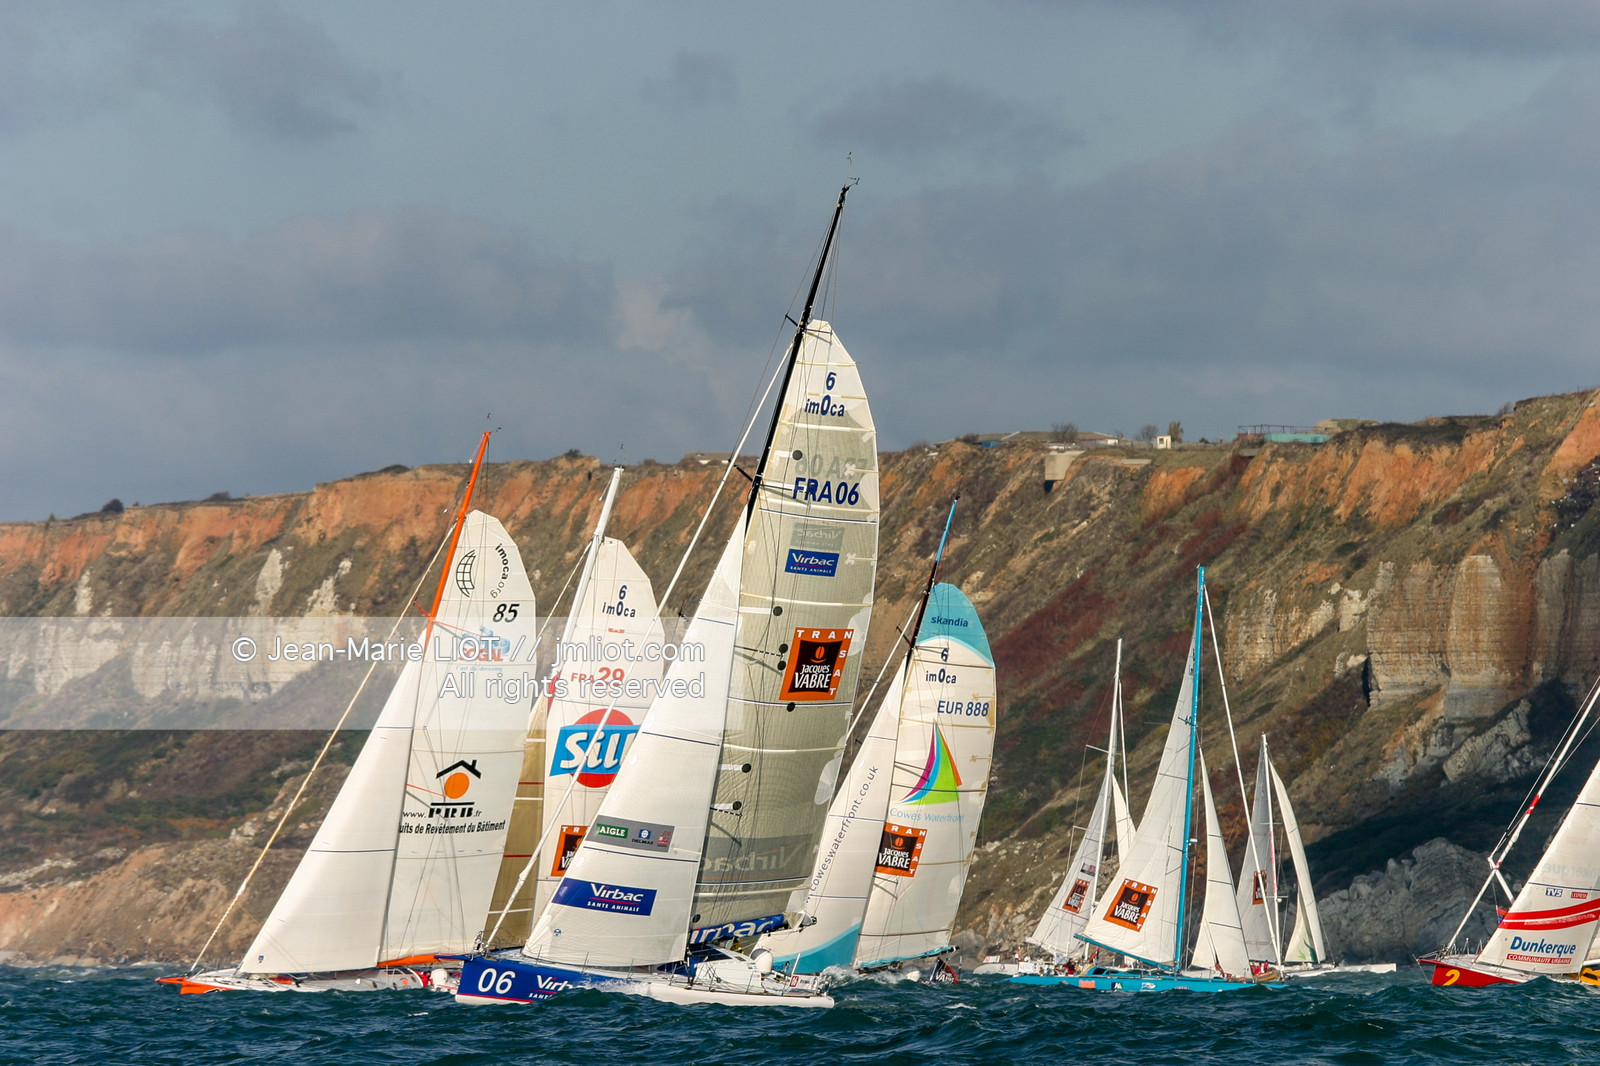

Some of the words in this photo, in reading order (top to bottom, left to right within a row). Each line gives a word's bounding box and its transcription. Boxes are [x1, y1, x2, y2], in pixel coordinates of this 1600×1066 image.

[825, 372, 837, 390] 6
[792, 553, 835, 566] Virbac
[490, 543, 510, 599] imoca.org
[618, 585, 627, 600] 6
[493, 603, 520, 623] 85
[931, 616, 969, 628] skandia
[940, 648, 949, 662] 6
[598, 667, 625, 687] 29
[800, 664, 830, 675] Jacques
[795, 672, 831, 688] VABRE
[937, 700, 963, 715] EUR
[965, 702, 989, 717] 888
[889, 807, 921, 821] Cowes
[924, 813, 965, 823] Waterfront
[400, 823, 413, 834] uits
[414, 822, 424, 834] de
[467, 822, 476, 833] du
[600, 826, 625, 836] AIGLE
[879, 852, 911, 868] VABRE
[883, 848, 909, 858] Jacques
[590, 883, 644, 902] Virbac
[587, 901, 609, 909] SANTE
[1114, 905, 1140, 923] VABRE
[1510, 936, 1576, 957] Dunkerque
[1508, 954, 1550, 963] COMMUNAUTE
[478, 968, 516, 994] 06
[537, 975, 584, 991] Virb
[1442, 969, 1460, 986] 2
